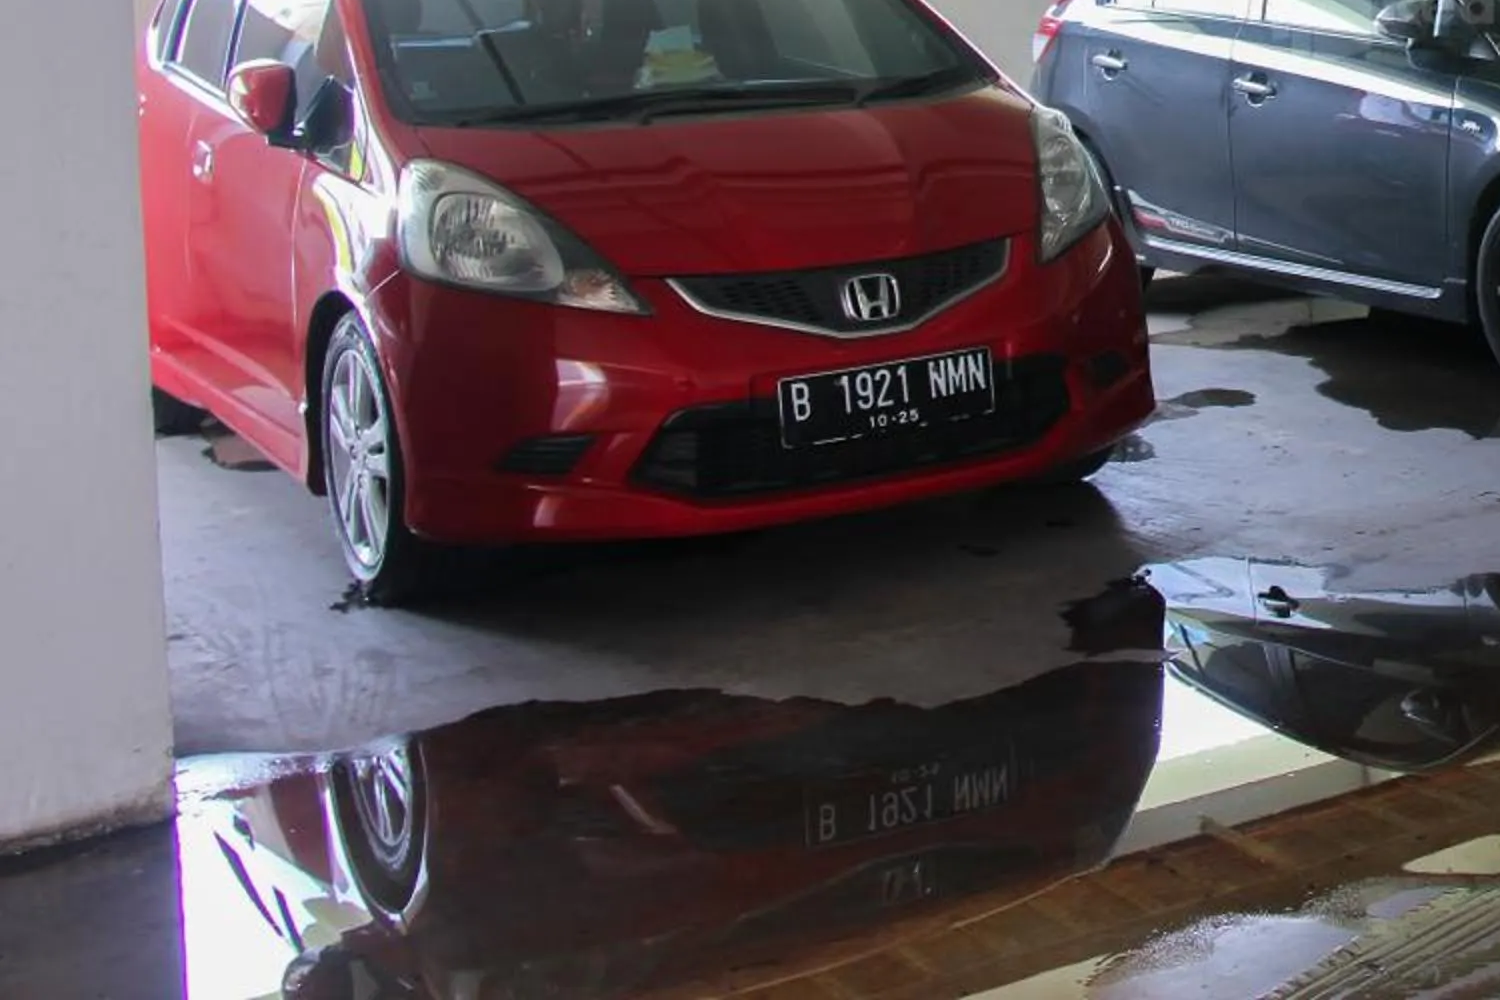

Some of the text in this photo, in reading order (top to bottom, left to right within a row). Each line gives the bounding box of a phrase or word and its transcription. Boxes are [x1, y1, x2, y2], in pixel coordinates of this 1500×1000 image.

[790, 353, 987, 422] B 1921 NMN
